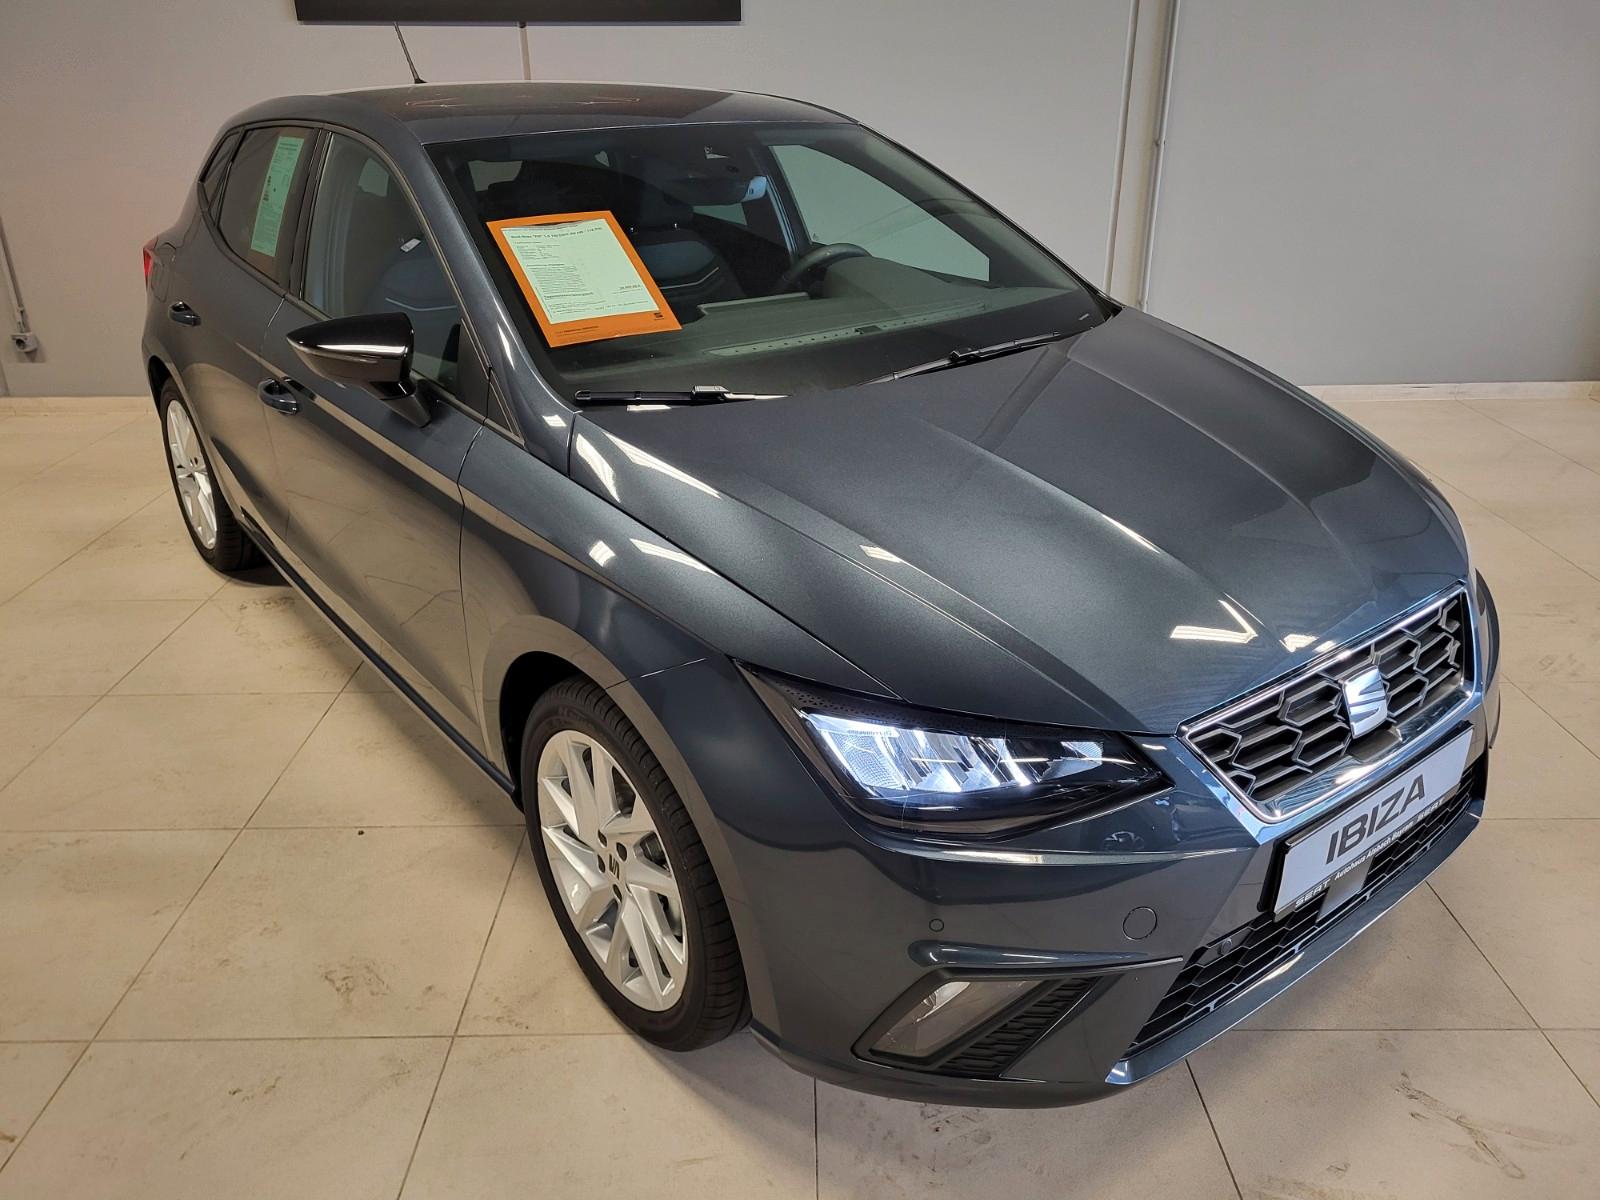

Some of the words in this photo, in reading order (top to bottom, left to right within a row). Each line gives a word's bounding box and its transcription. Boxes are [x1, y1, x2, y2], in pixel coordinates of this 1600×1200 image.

[1325, 774, 1426, 865] IBIZA
[1295, 878, 1332, 908] SEAT
[1334, 855, 1367, 881] Autohaus
